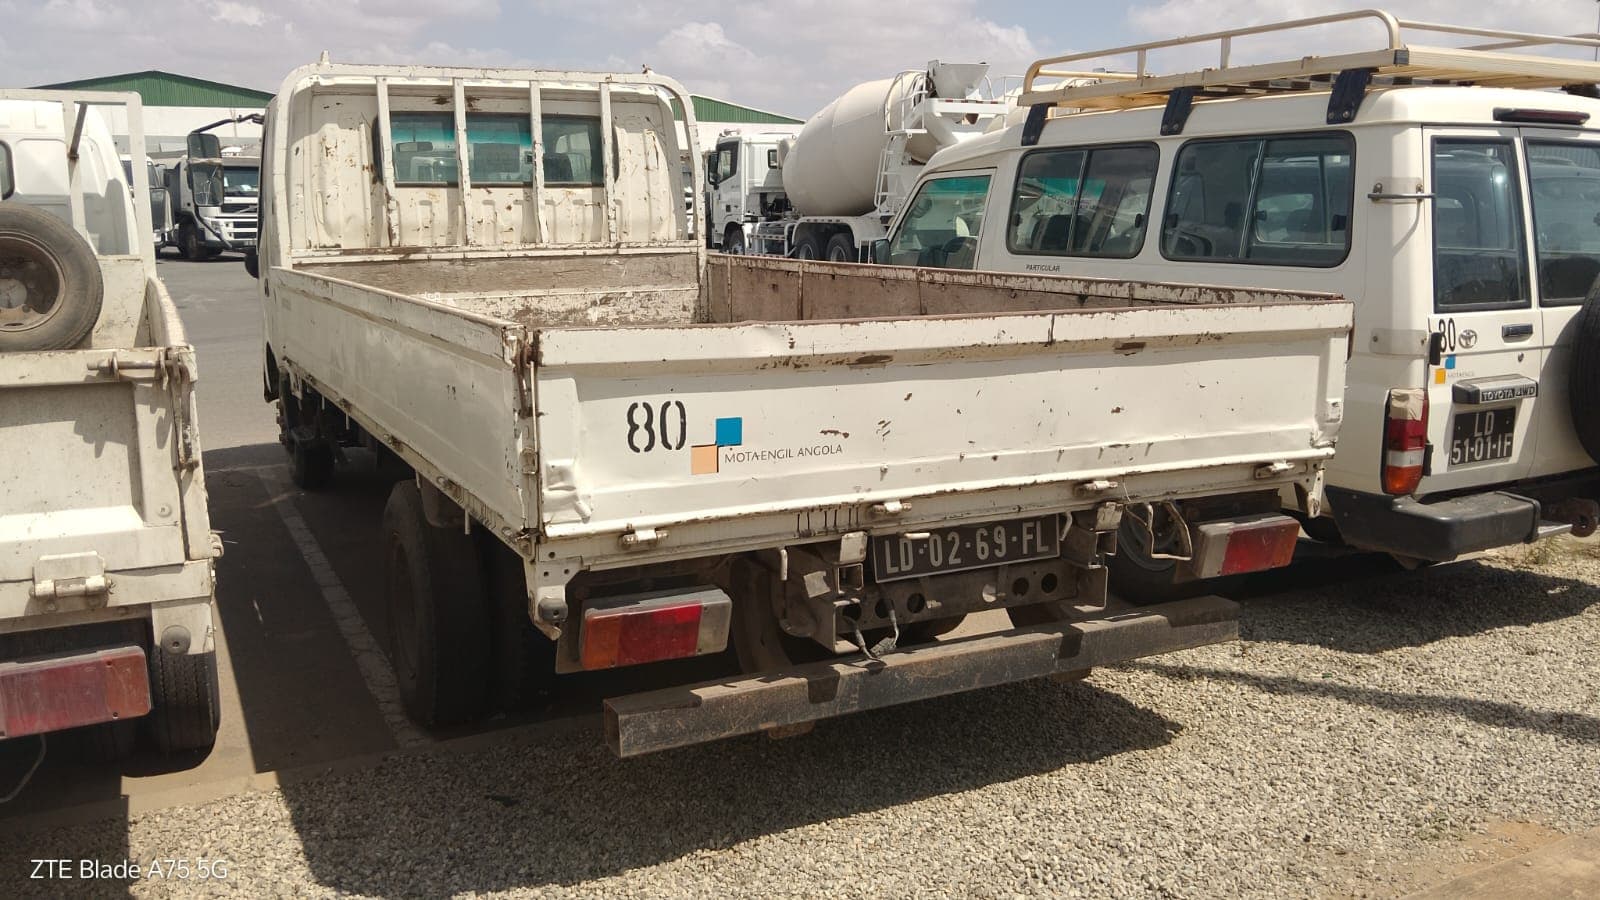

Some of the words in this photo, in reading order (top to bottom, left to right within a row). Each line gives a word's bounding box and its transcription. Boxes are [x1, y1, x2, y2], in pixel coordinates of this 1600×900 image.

[1025, 263, 1061, 272] PARTICULAR
[1482, 388, 1514, 401] TOYOTA
[626, 400, 687, 453] 80
[1474, 411, 1495, 437] LD
[797, 444, 843, 457] ANGOLA
